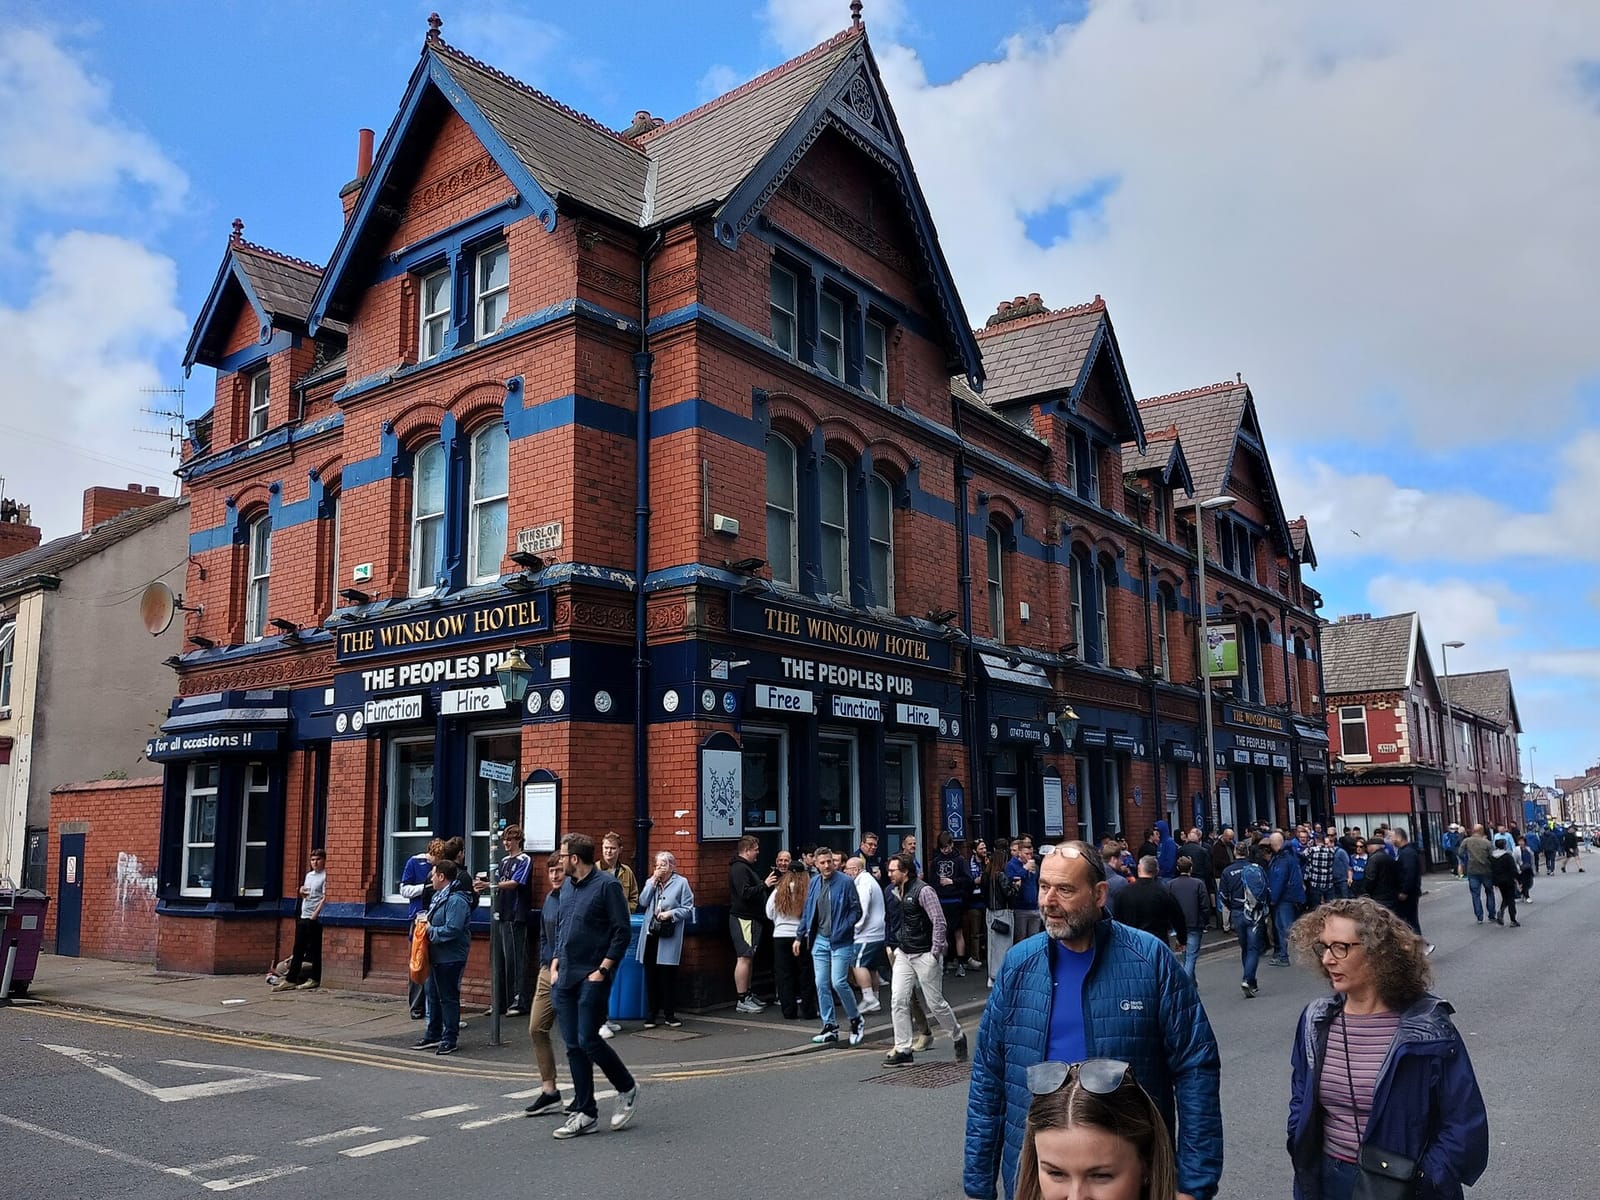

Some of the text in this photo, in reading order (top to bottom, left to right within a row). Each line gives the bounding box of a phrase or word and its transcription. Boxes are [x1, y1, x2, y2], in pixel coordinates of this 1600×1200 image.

[519, 524, 560, 543] WINSLOW
[521, 536, 556, 552] STREET
[341, 600, 541, 653] THE WINSLOW HOTEL
[764, 608, 930, 661] THE WINSLOW HOTEL
[362, 670, 395, 691] THE
[399, 655, 480, 687] PEOPLES
[781, 657, 913, 696] THE PEOPLES PUB
[456, 690, 490, 712] Hire
[768, 686, 801, 710] Free
[833, 695, 881, 720] Function
[366, 698, 420, 723] Function
[906, 704, 930, 725] Hire
[155, 738, 168, 753] for
[170, 736, 181, 751] all
[182, 733, 239, 750] occasions
[1235, 734, 1277, 751] THE PEOPLES PUB
[1356, 777, 1386, 785] SALON
